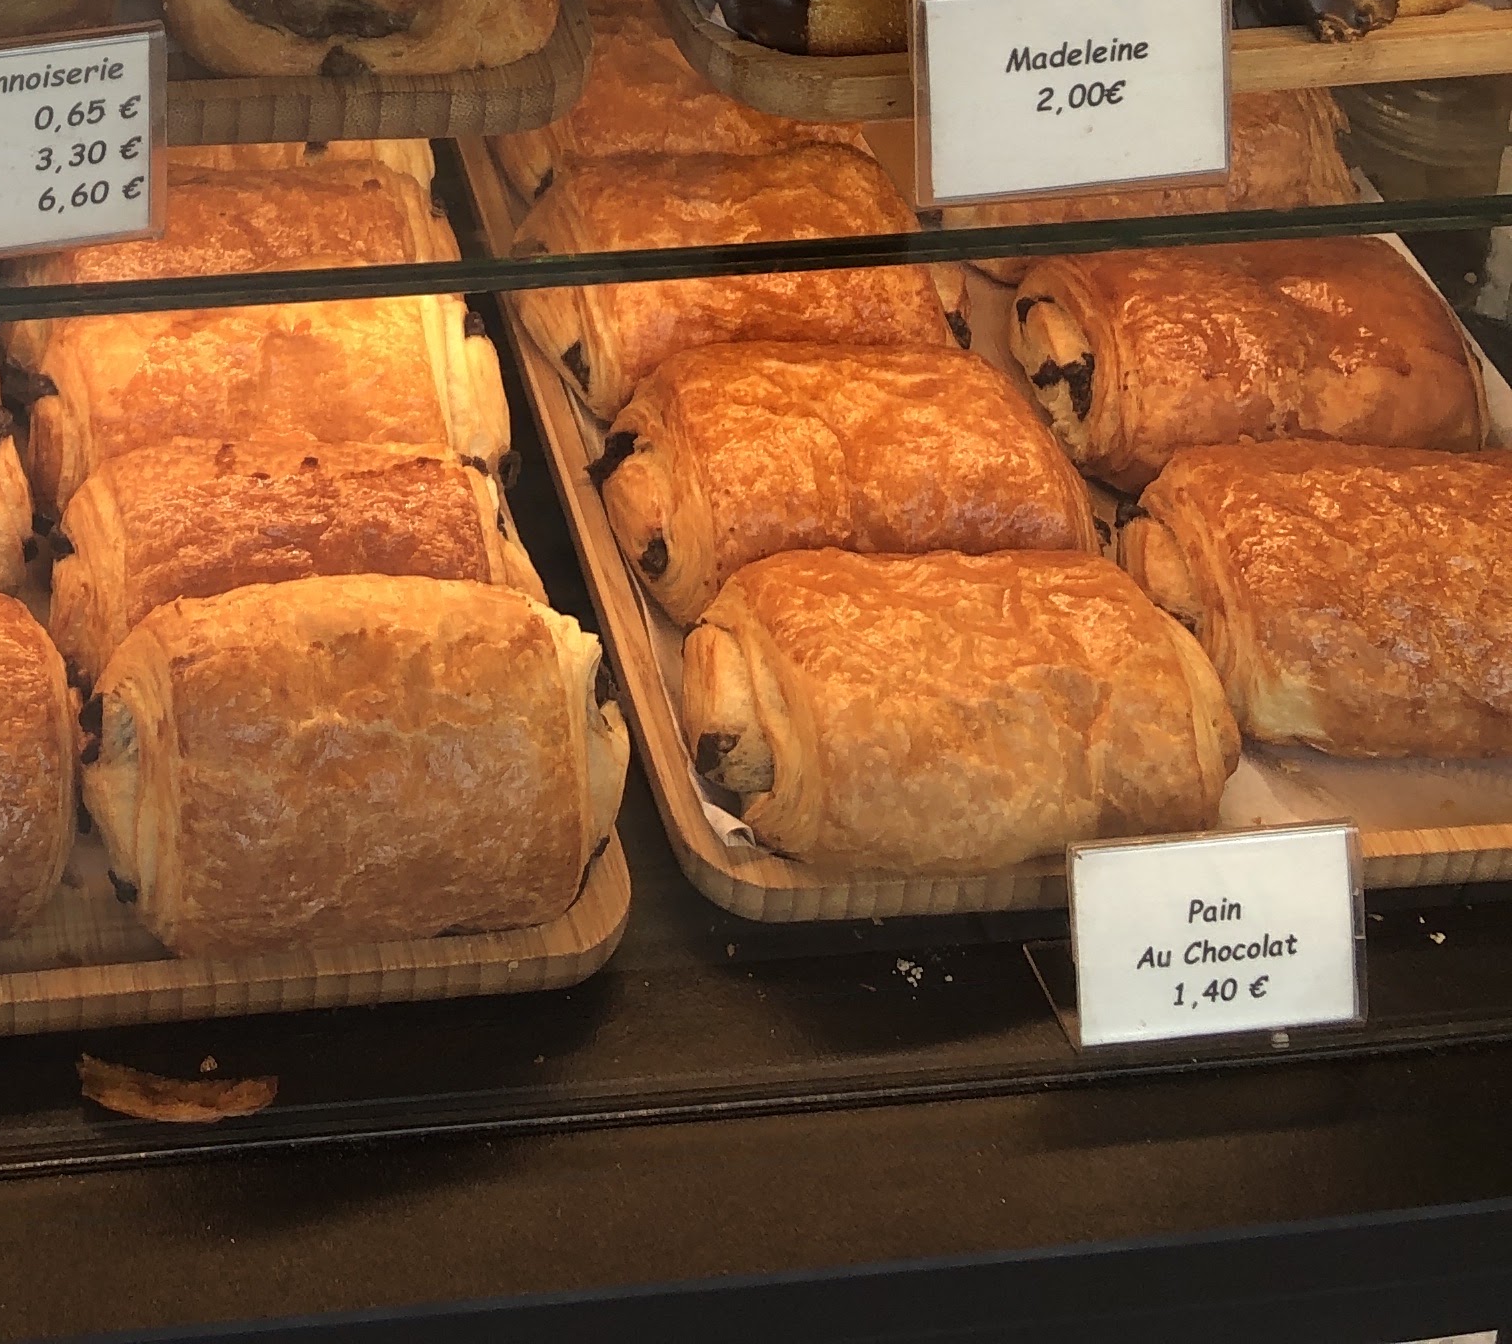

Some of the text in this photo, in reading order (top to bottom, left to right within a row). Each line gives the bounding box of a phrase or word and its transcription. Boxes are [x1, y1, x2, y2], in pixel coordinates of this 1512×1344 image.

[1006, 38, 1149, 73] Madeleine
[34, 99, 106, 133] 0,65
[119, 96, 141, 119] €
[1036, 80, 1126, 115] 2,00€
[36, 140, 107, 173] 3,30
[119, 137, 142, 160] €
[39, 180, 109, 214] 6,60
[122, 176, 144, 200] €
[1188, 898, 1241, 923] Pain
[1137, 934, 1298, 969] Au Chocolat
[1173, 975, 1269, 1009] 1,40 €
